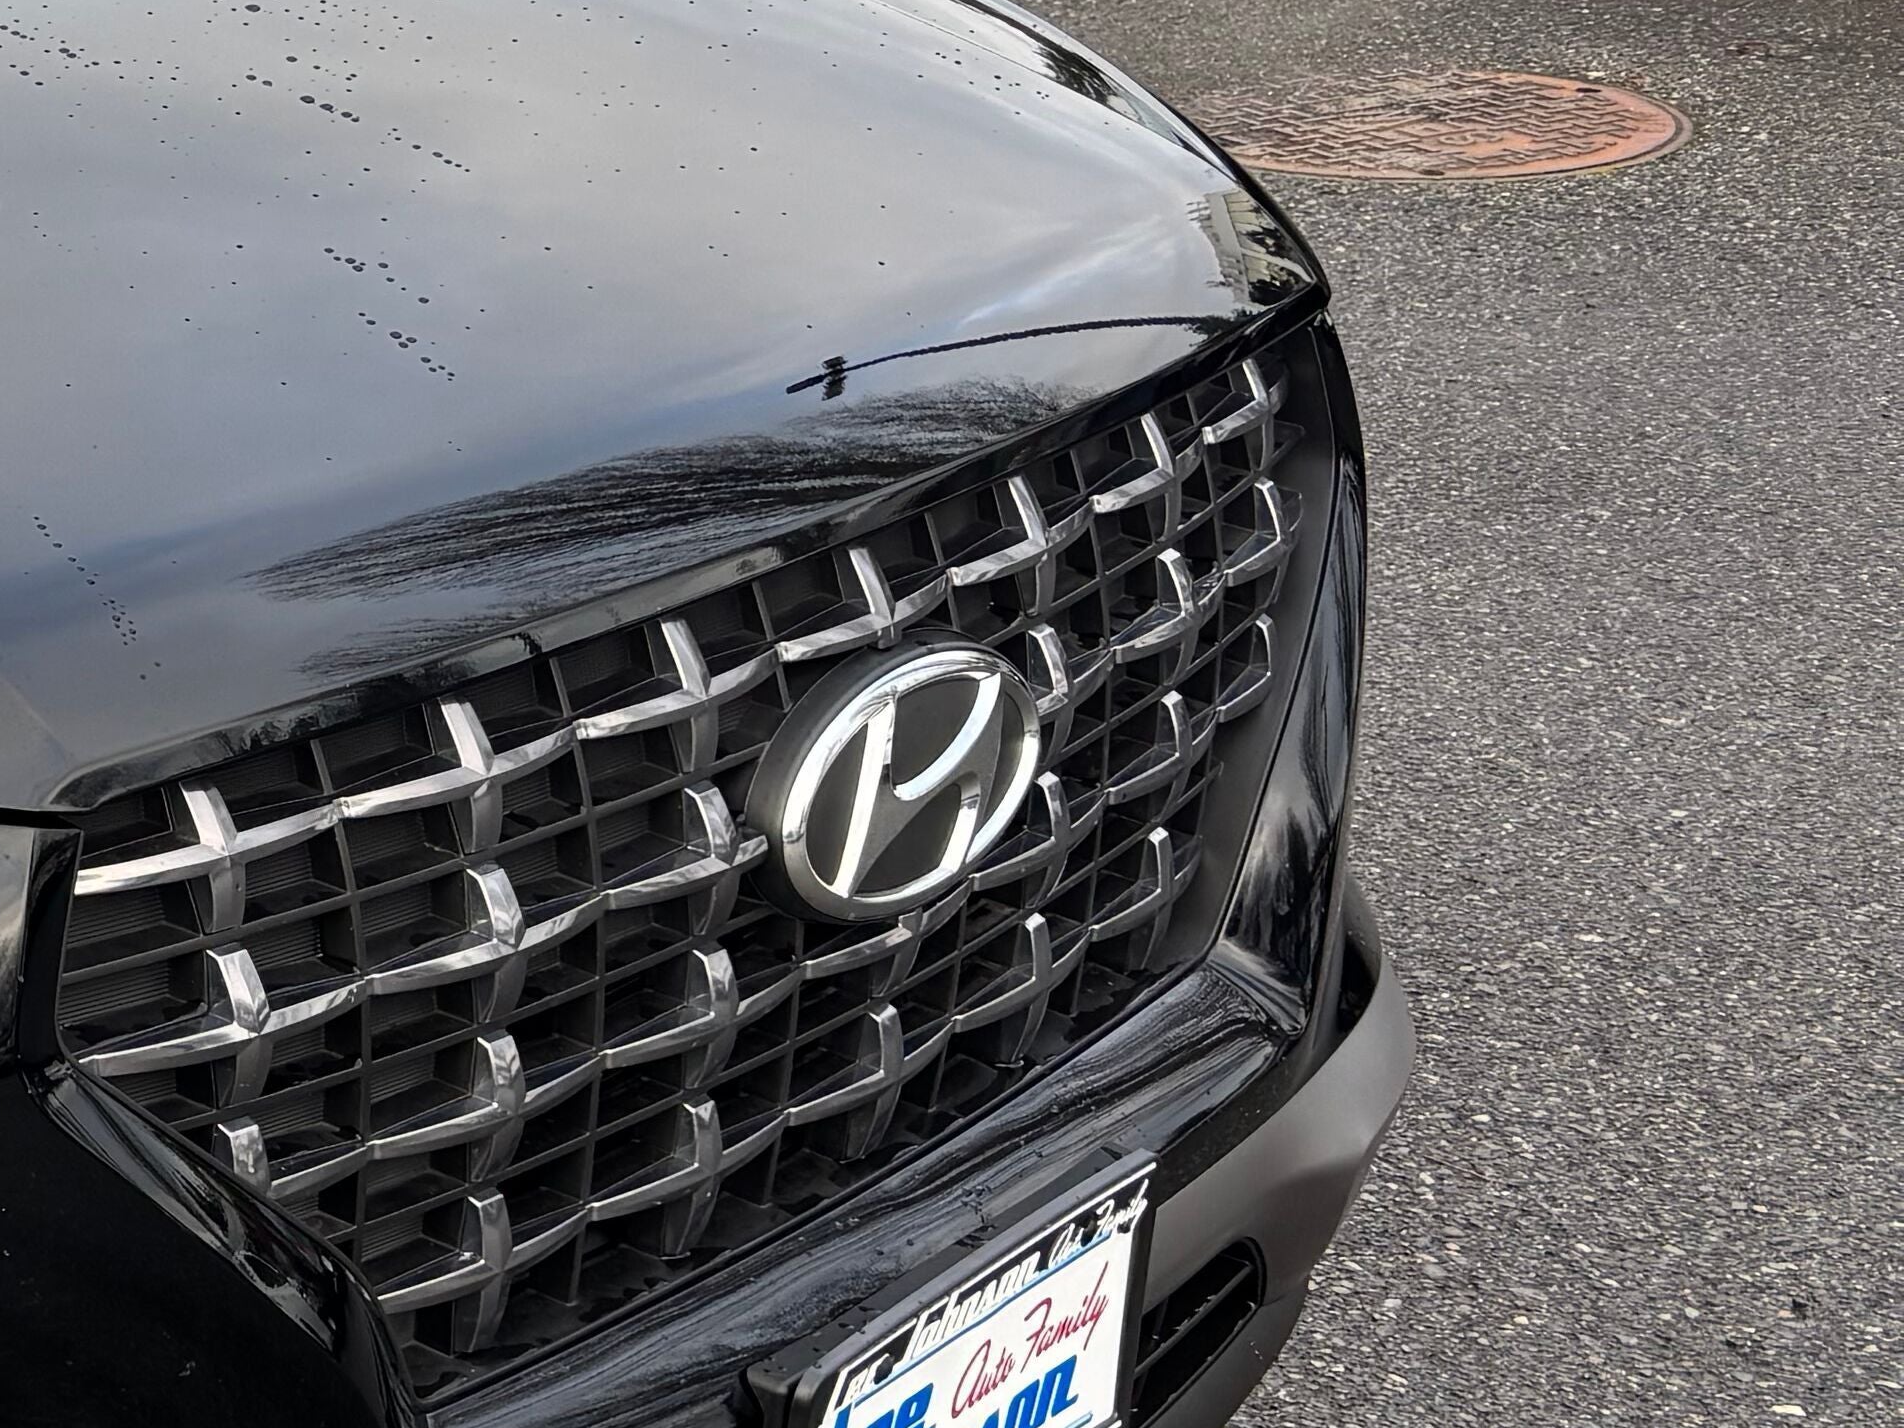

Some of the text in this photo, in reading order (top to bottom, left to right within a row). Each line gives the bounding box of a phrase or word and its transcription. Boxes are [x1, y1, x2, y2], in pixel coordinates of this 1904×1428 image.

[892, 1250, 1042, 1369] Johnson
[951, 1260, 1110, 1420] Auto Family
